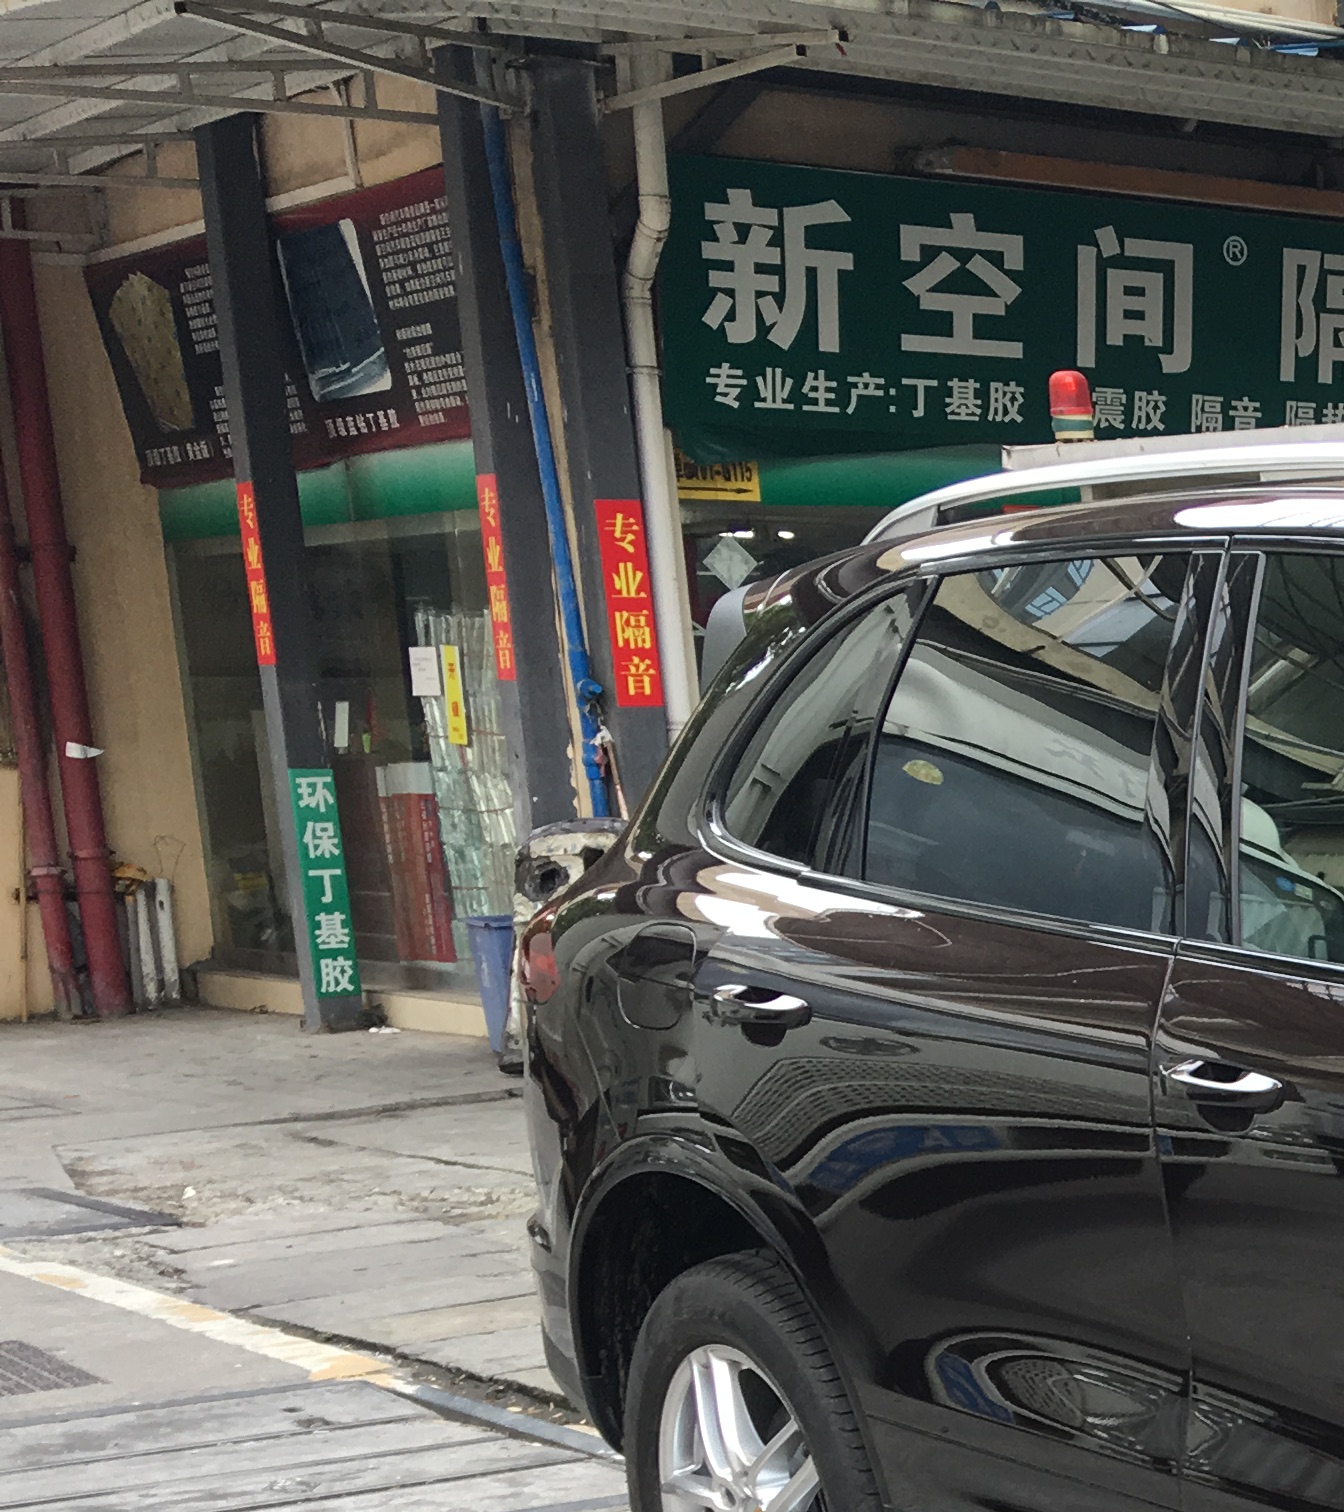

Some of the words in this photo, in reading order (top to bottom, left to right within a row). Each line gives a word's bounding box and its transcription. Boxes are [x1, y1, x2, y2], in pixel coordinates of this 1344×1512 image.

[239, 493, 272, 656] 专业隔音
[481, 487, 512, 670] 专业隔音
[604, 512, 656, 696] 专业隔音
[296, 776, 355, 993] 环保丁基胶
